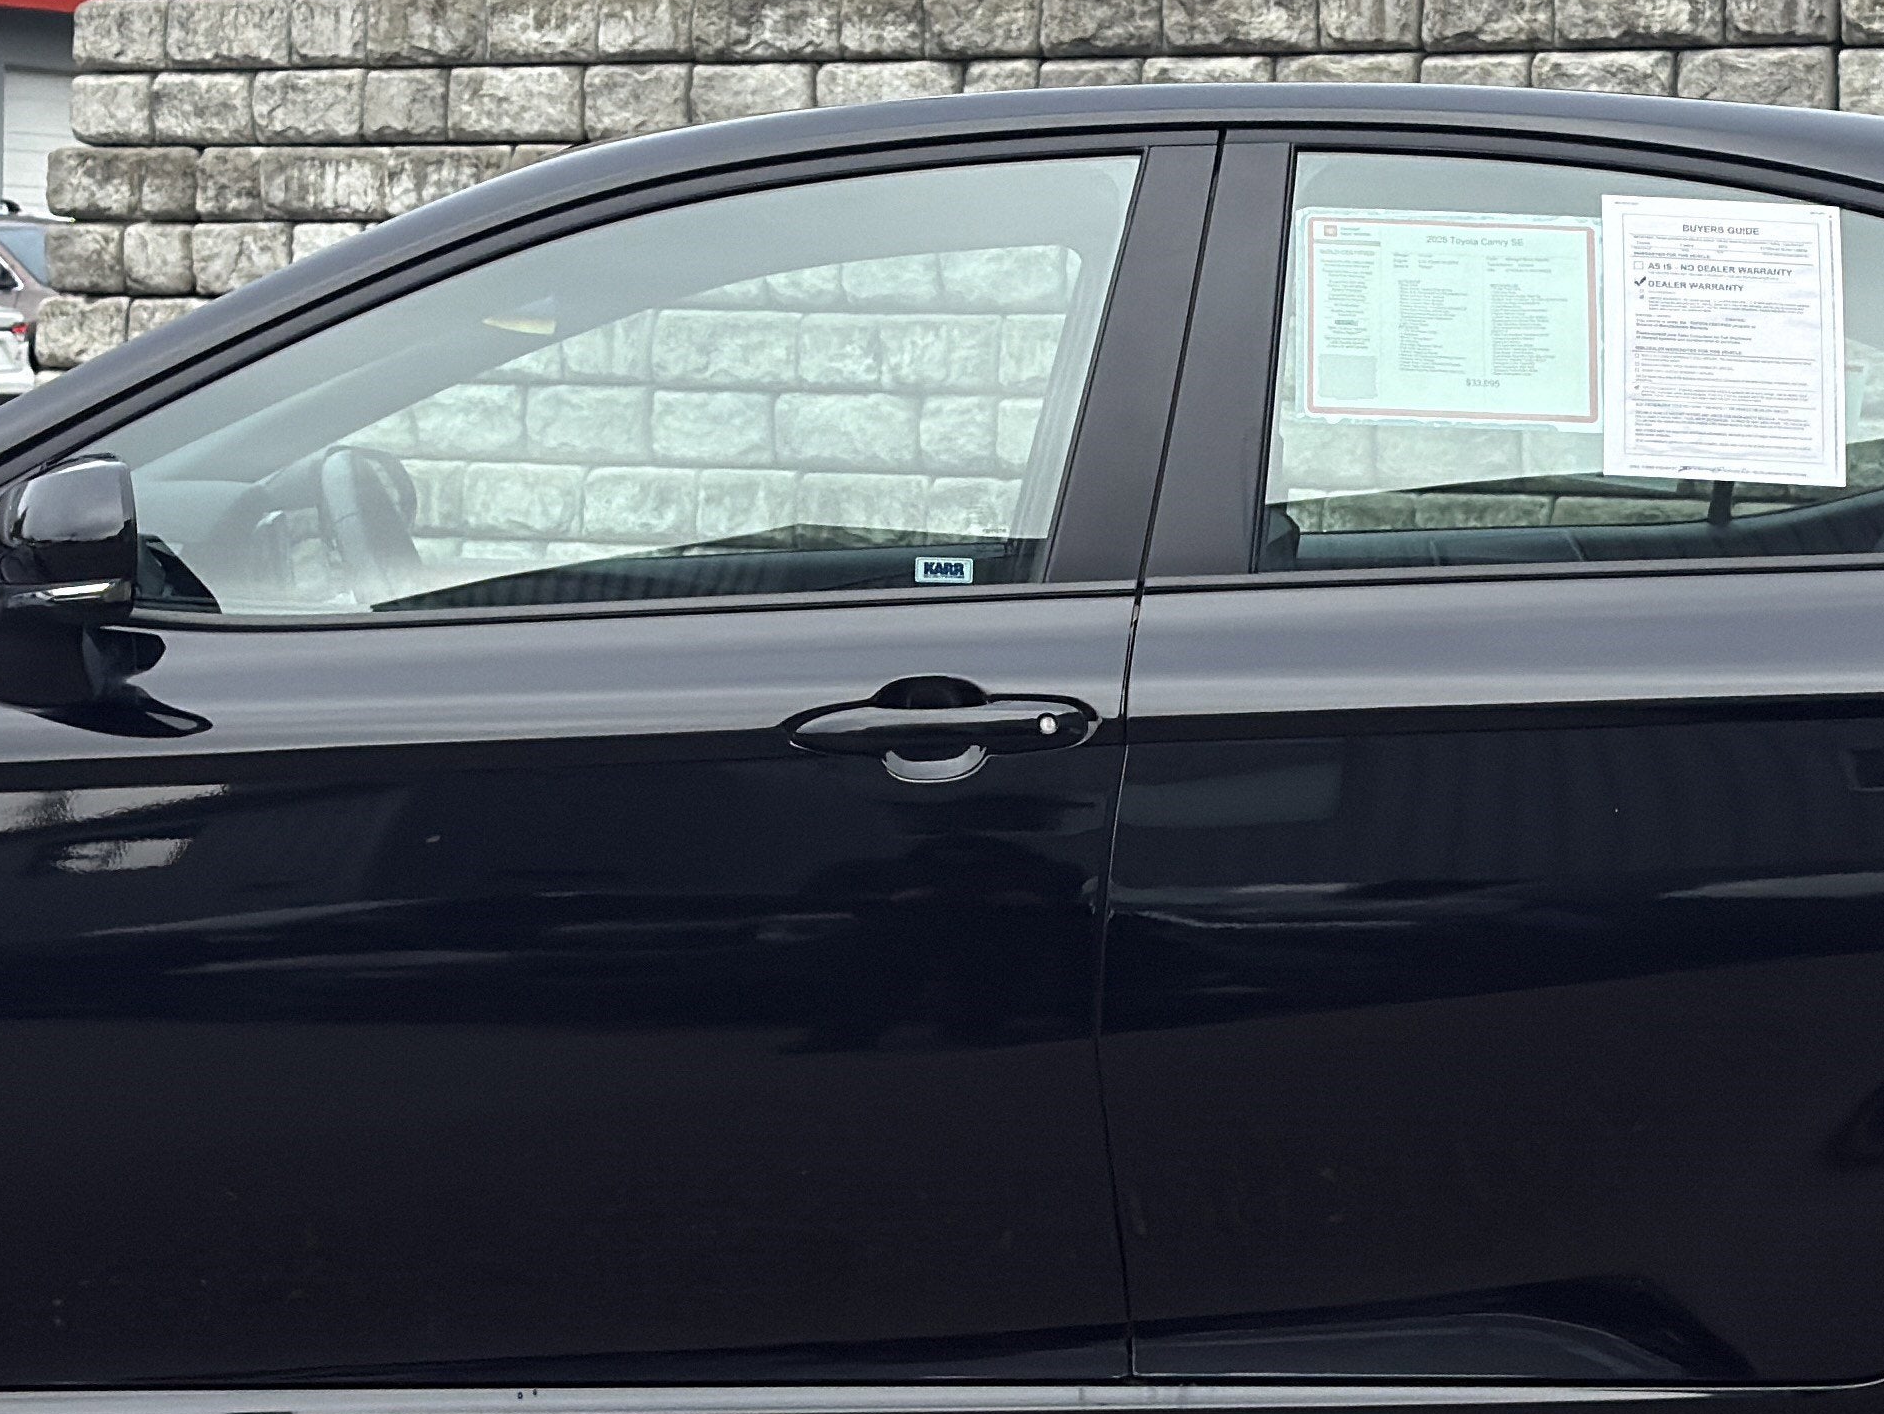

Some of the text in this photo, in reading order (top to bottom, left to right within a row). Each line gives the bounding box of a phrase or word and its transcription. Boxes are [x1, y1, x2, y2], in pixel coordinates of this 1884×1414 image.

[1682, 224, 1760, 236] BUYERS GUIDE
[1450, 236, 1479, 247] Toyota
[1481, 237, 1509, 248] Camry
[1648, 262, 1661, 271] AS
[1663, 263, 1672, 271] IS
[1680, 264, 1695, 272] NO
[1697, 264, 1736, 275] DEALER
[1738, 266, 1793, 277] WARRANTY
[1648, 280, 1744, 292] DEALER WARRANTY
[923, 561, 965, 576] KARR
